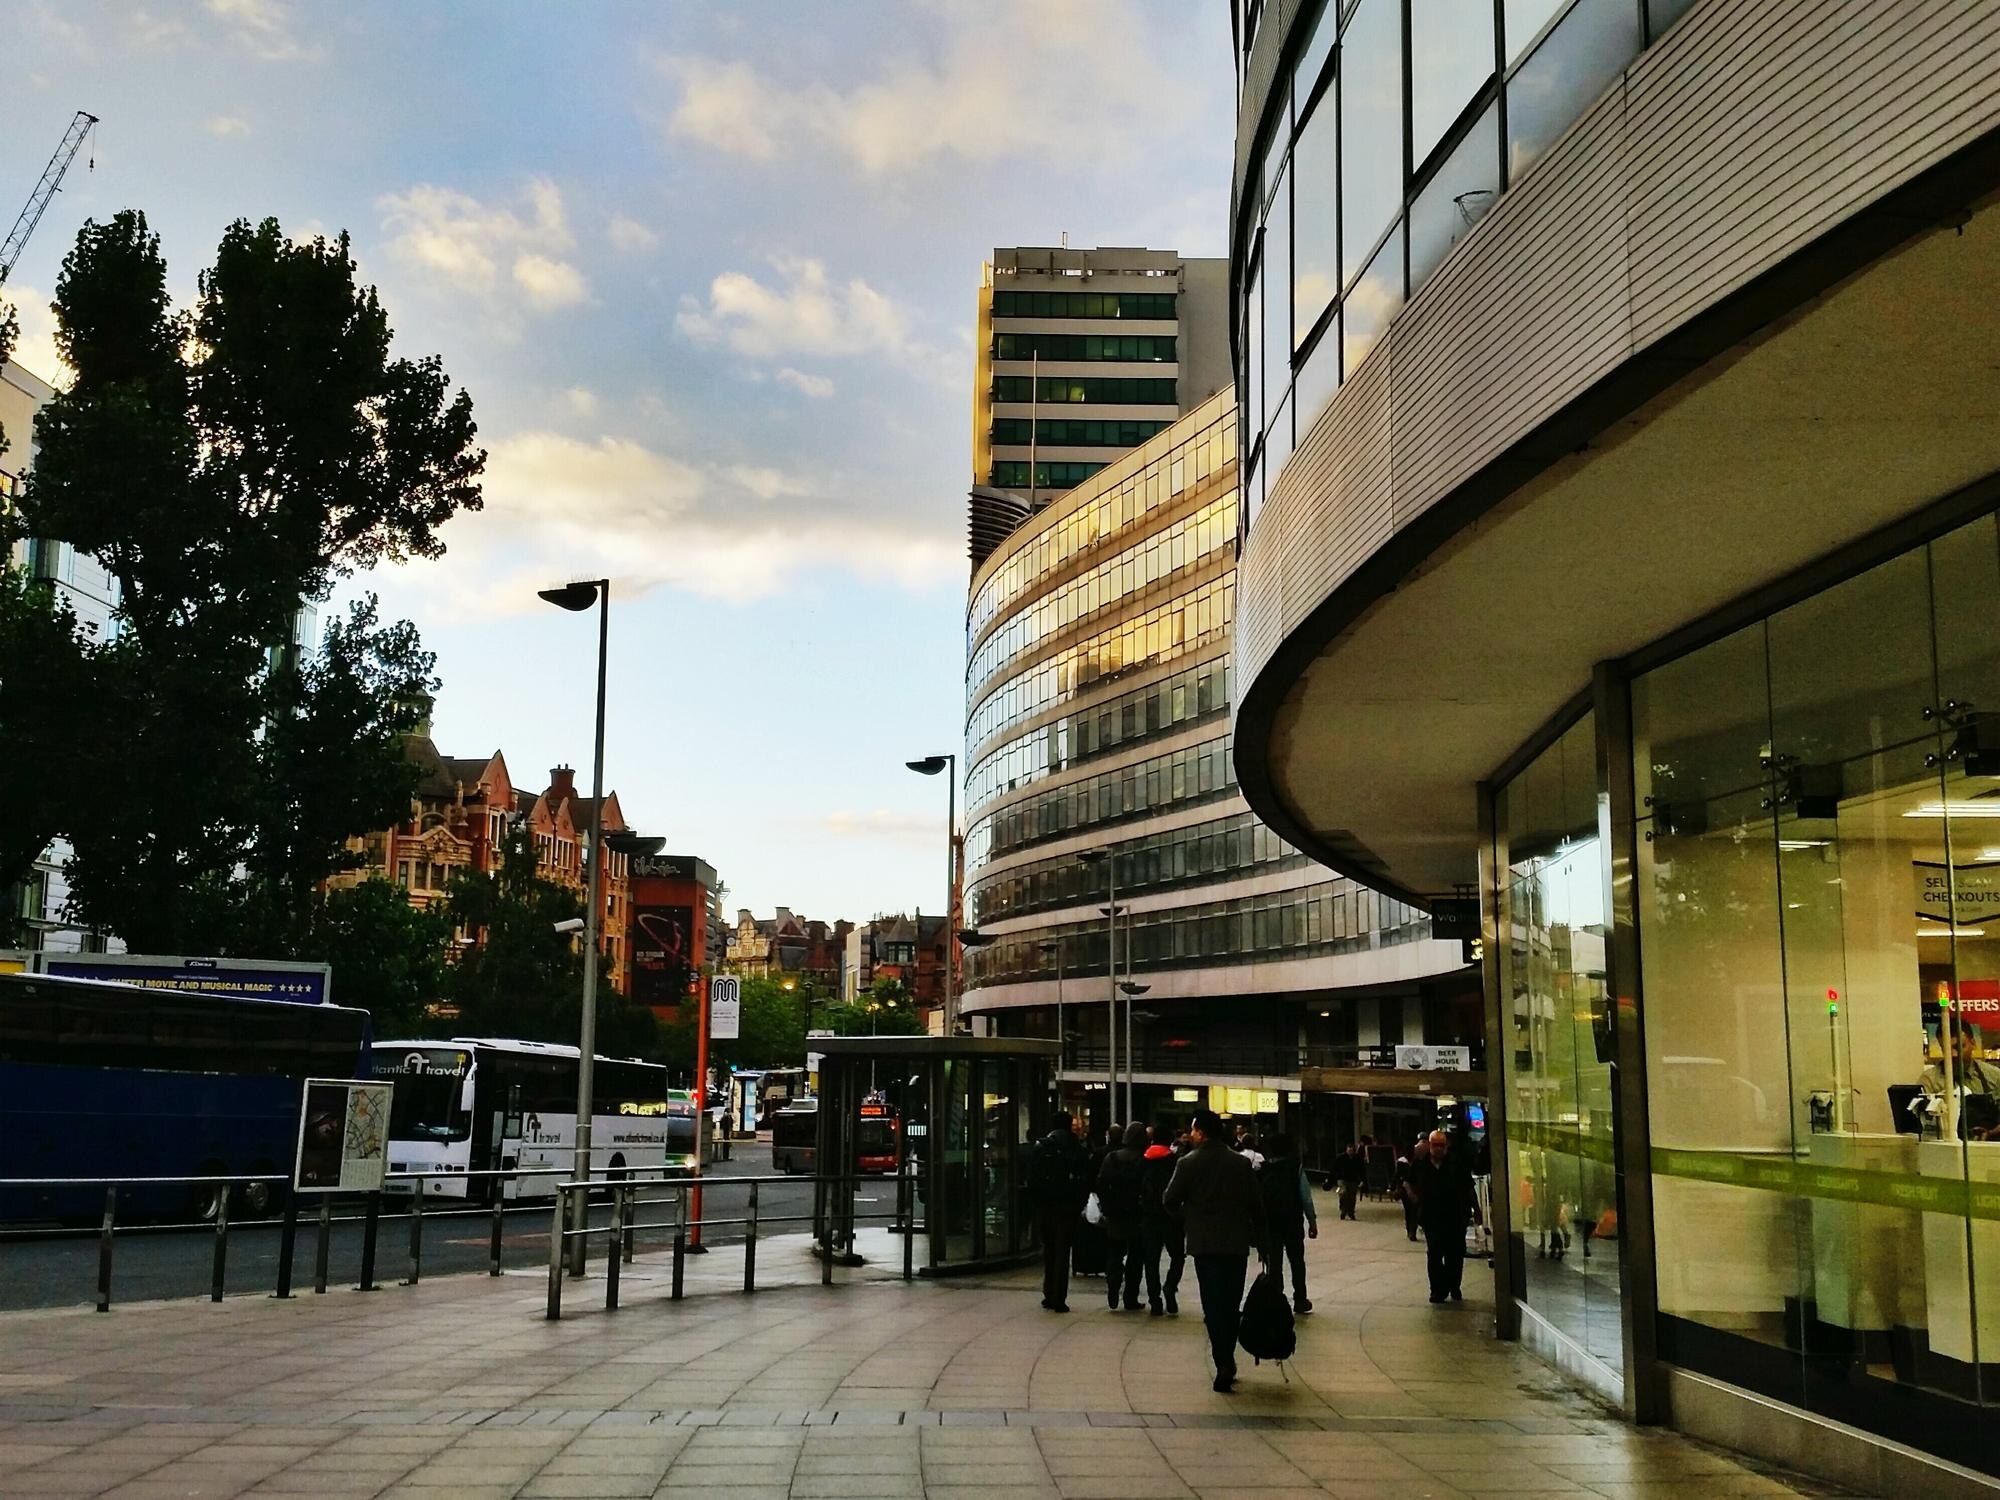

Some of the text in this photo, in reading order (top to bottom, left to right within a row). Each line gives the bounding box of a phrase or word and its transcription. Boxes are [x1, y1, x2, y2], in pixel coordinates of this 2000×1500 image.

[1926, 877, 1951, 888] SEL
[1923, 891, 2000, 902] CHEKOUTS
[146, 979, 178, 989] MOVIE
[179, 981, 199, 989] AND
[200, 981, 243, 991] MUSICAL
[1949, 998, 1999, 1012] OFFERS
[371, 1064, 411, 1074] tlantic
[426, 1065, 465, 1076] travel
